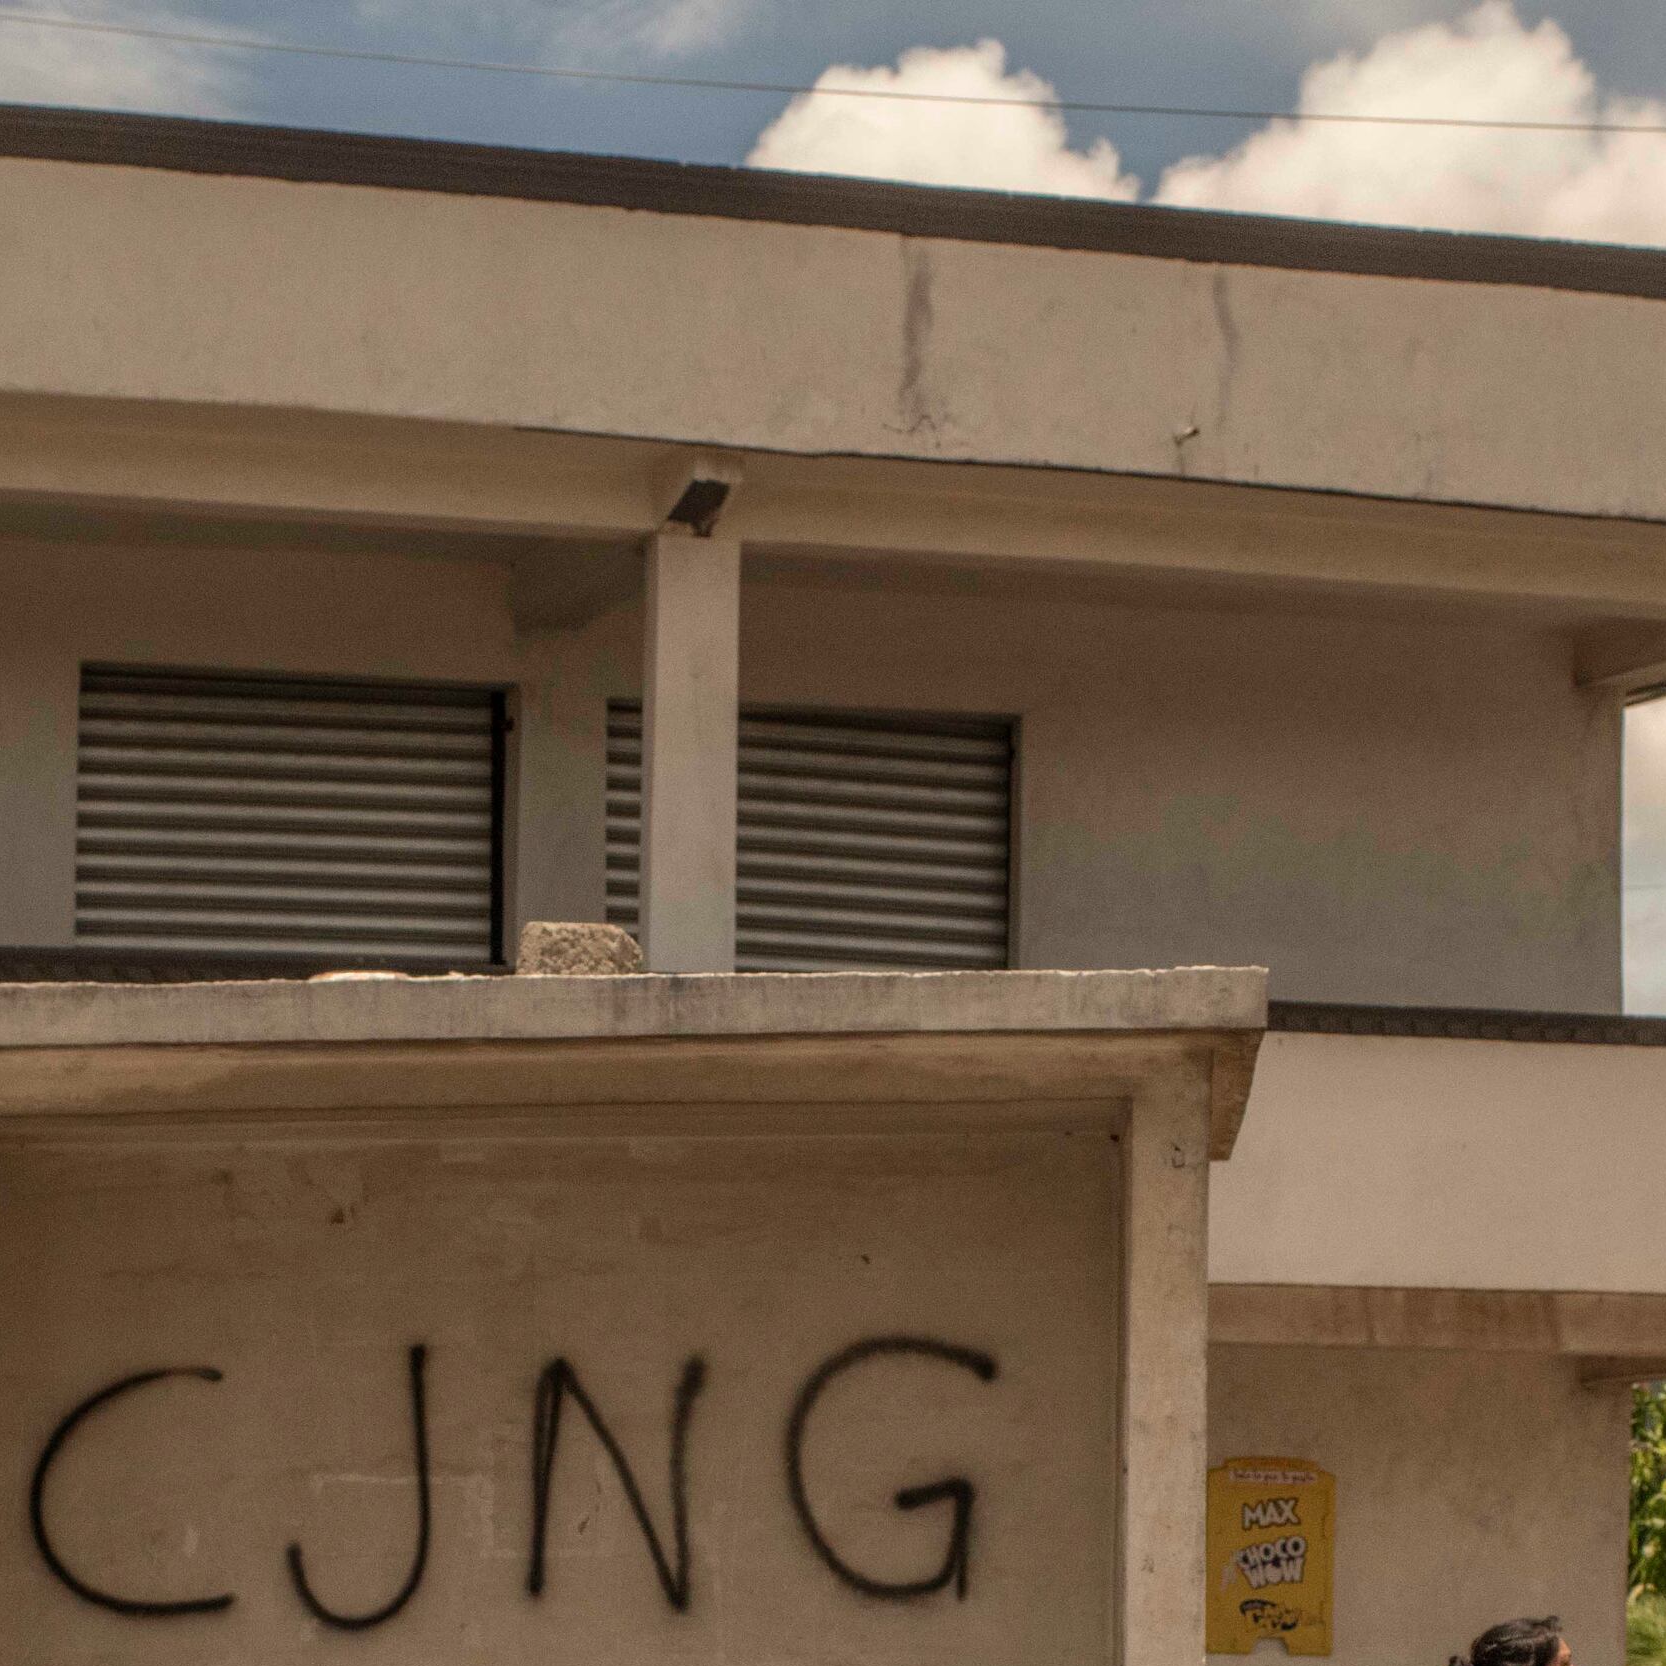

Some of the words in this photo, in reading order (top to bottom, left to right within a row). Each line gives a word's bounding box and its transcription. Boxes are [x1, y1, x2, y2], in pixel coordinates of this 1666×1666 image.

[28, 1336, 1001, 1631] CJNG
[1242, 1497, 1301, 1531] MAX
[1237, 1536, 1306, 1567] CHOCO
[1242, 1556, 1304, 1589] WOW
